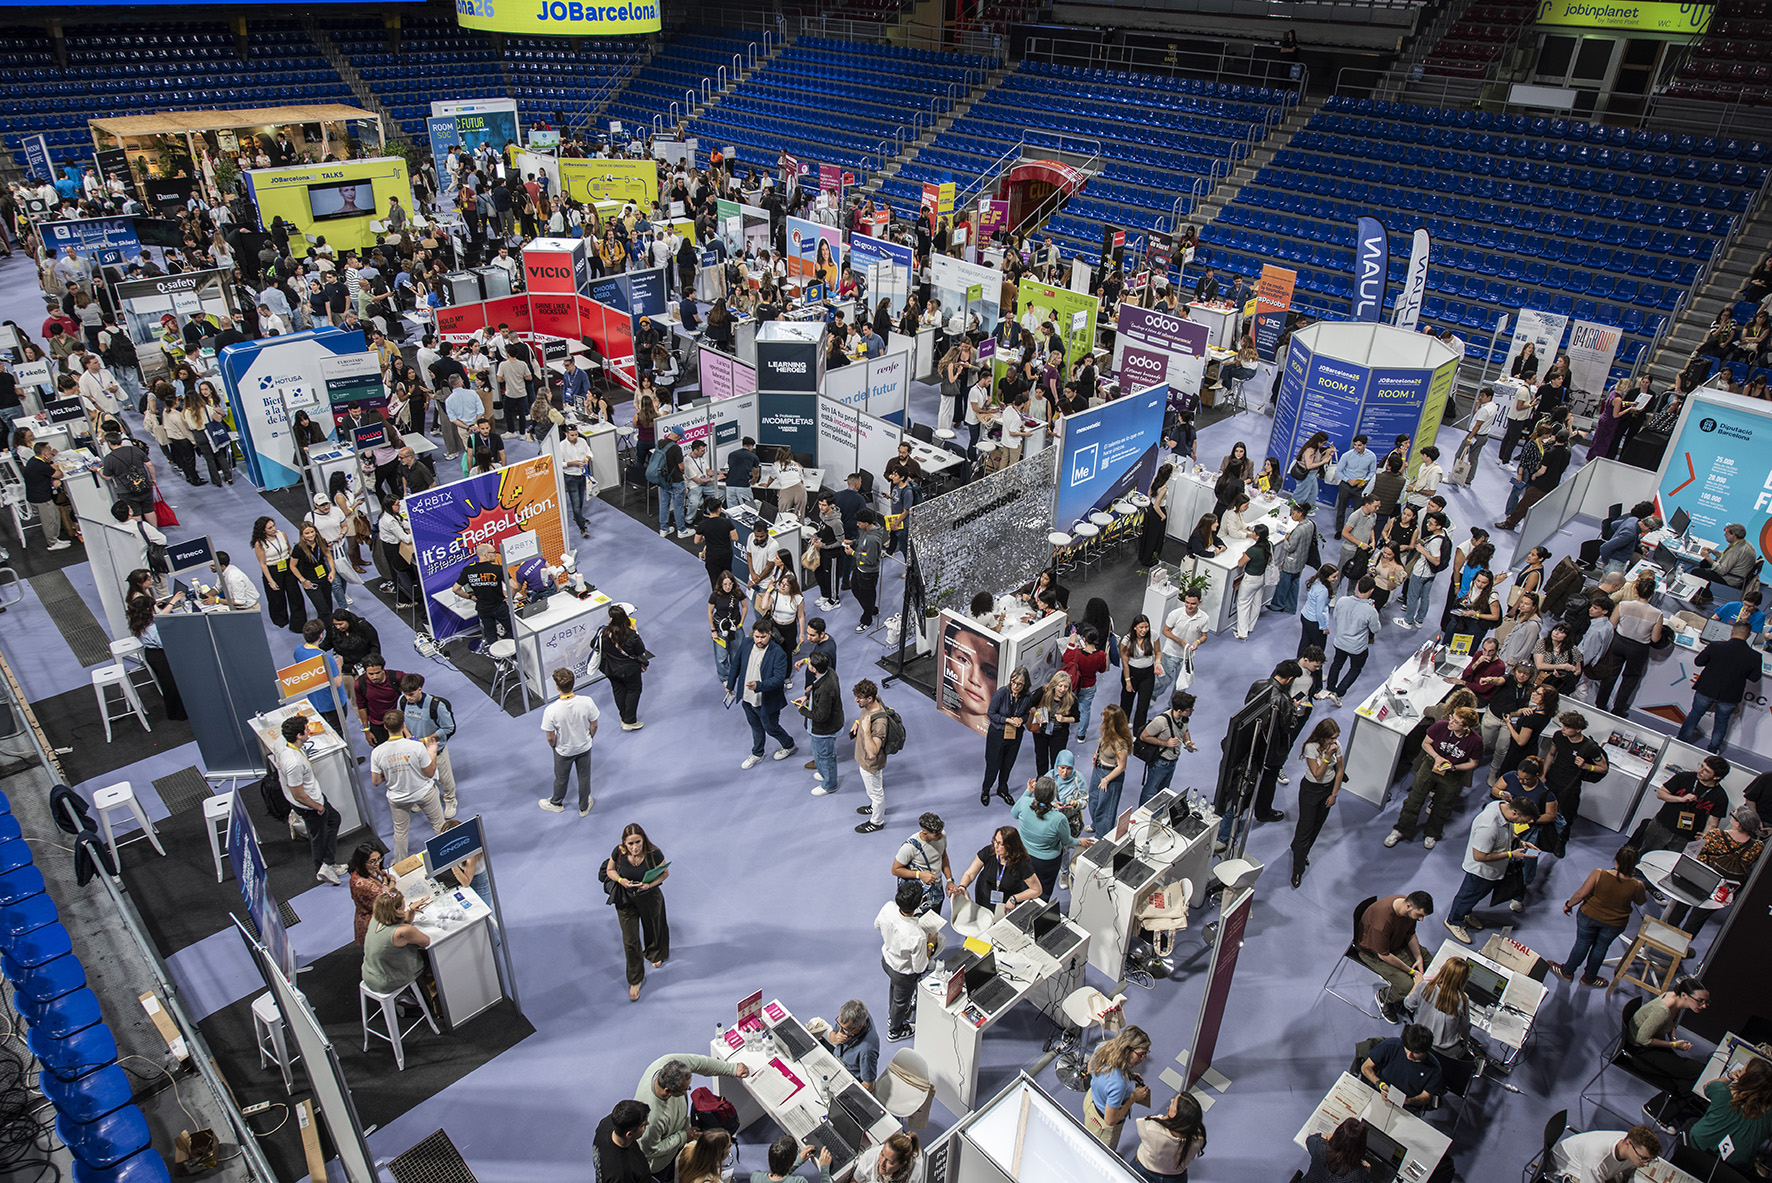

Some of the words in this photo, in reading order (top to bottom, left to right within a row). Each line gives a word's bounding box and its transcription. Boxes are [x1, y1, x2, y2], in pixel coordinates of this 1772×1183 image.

[1564, 3, 1639, 19] jobinplanet
[432, 123, 453, 131] ROOM
[462, 117, 485, 129] FUTUR
[437, 131, 451, 139] SOC
[322, 172, 344, 180] TALKS
[600, 174, 605, 182] 4
[624, 176, 631, 184] 5
[156, 192, 180, 201] Damm
[644, 197, 650, 205] 6
[982, 202, 989, 210] EF
[980, 210, 1003, 224] EF
[528, 266, 571, 279] VICIO
[593, 283, 616, 293] CHOOSE
[535, 303, 553, 311] SHINE
[553, 302, 565, 310] LIKE
[566, 302, 571, 310] A
[539, 308, 569, 316] ROCKSTAR
[440, 317, 455, 325] HOLD
[1145, 314, 1179, 333] odoo
[440, 324, 458, 332] DRINK
[1573, 326, 1617, 353] G4GROUP
[546, 343, 567, 354] pimec
[876, 361, 899, 375] renfe
[1128, 355, 1162, 371] odoo
[26, 368, 47, 377] skello
[1318, 364, 1360, 380] JOBarcelona26
[275, 375, 303, 385] HOTUSA
[1318, 377, 1348, 393] ROOM
[1349, 386, 1356, 395] 2
[872, 381, 898, 398] futur
[1378, 390, 1409, 398] ROOM
[1411, 390, 1416, 398] 1
[50, 404, 81, 416] HCLTech
[820, 403, 830, 413] Sin
[831, 407, 838, 416] IA
[838, 410, 844, 419] tu
[762, 417, 814, 426] INCOMPLETAS
[820, 422, 852, 440] complétala
[1718, 428, 1751, 442] Barcelona
[1720, 423, 1753, 436] Diputació
[821, 431, 831, 440] con
[832, 434, 857, 450] nosotros
[1716, 456, 1735, 466] 25.000
[1074, 466, 1089, 481] Me
[425, 492, 453, 507] RBTX
[1701, 492, 1722, 503] 100.000
[952, 488, 1021, 531] mesoestetic
[450, 542, 461, 554] a
[462, 498, 556, 548] ReBeLution.
[515, 539, 535, 550] RBTX
[183, 549, 204, 559] ineco
[558, 623, 587, 640] RBTX
[946, 668, 959, 681] Me
[439, 836, 471, 857] engie
